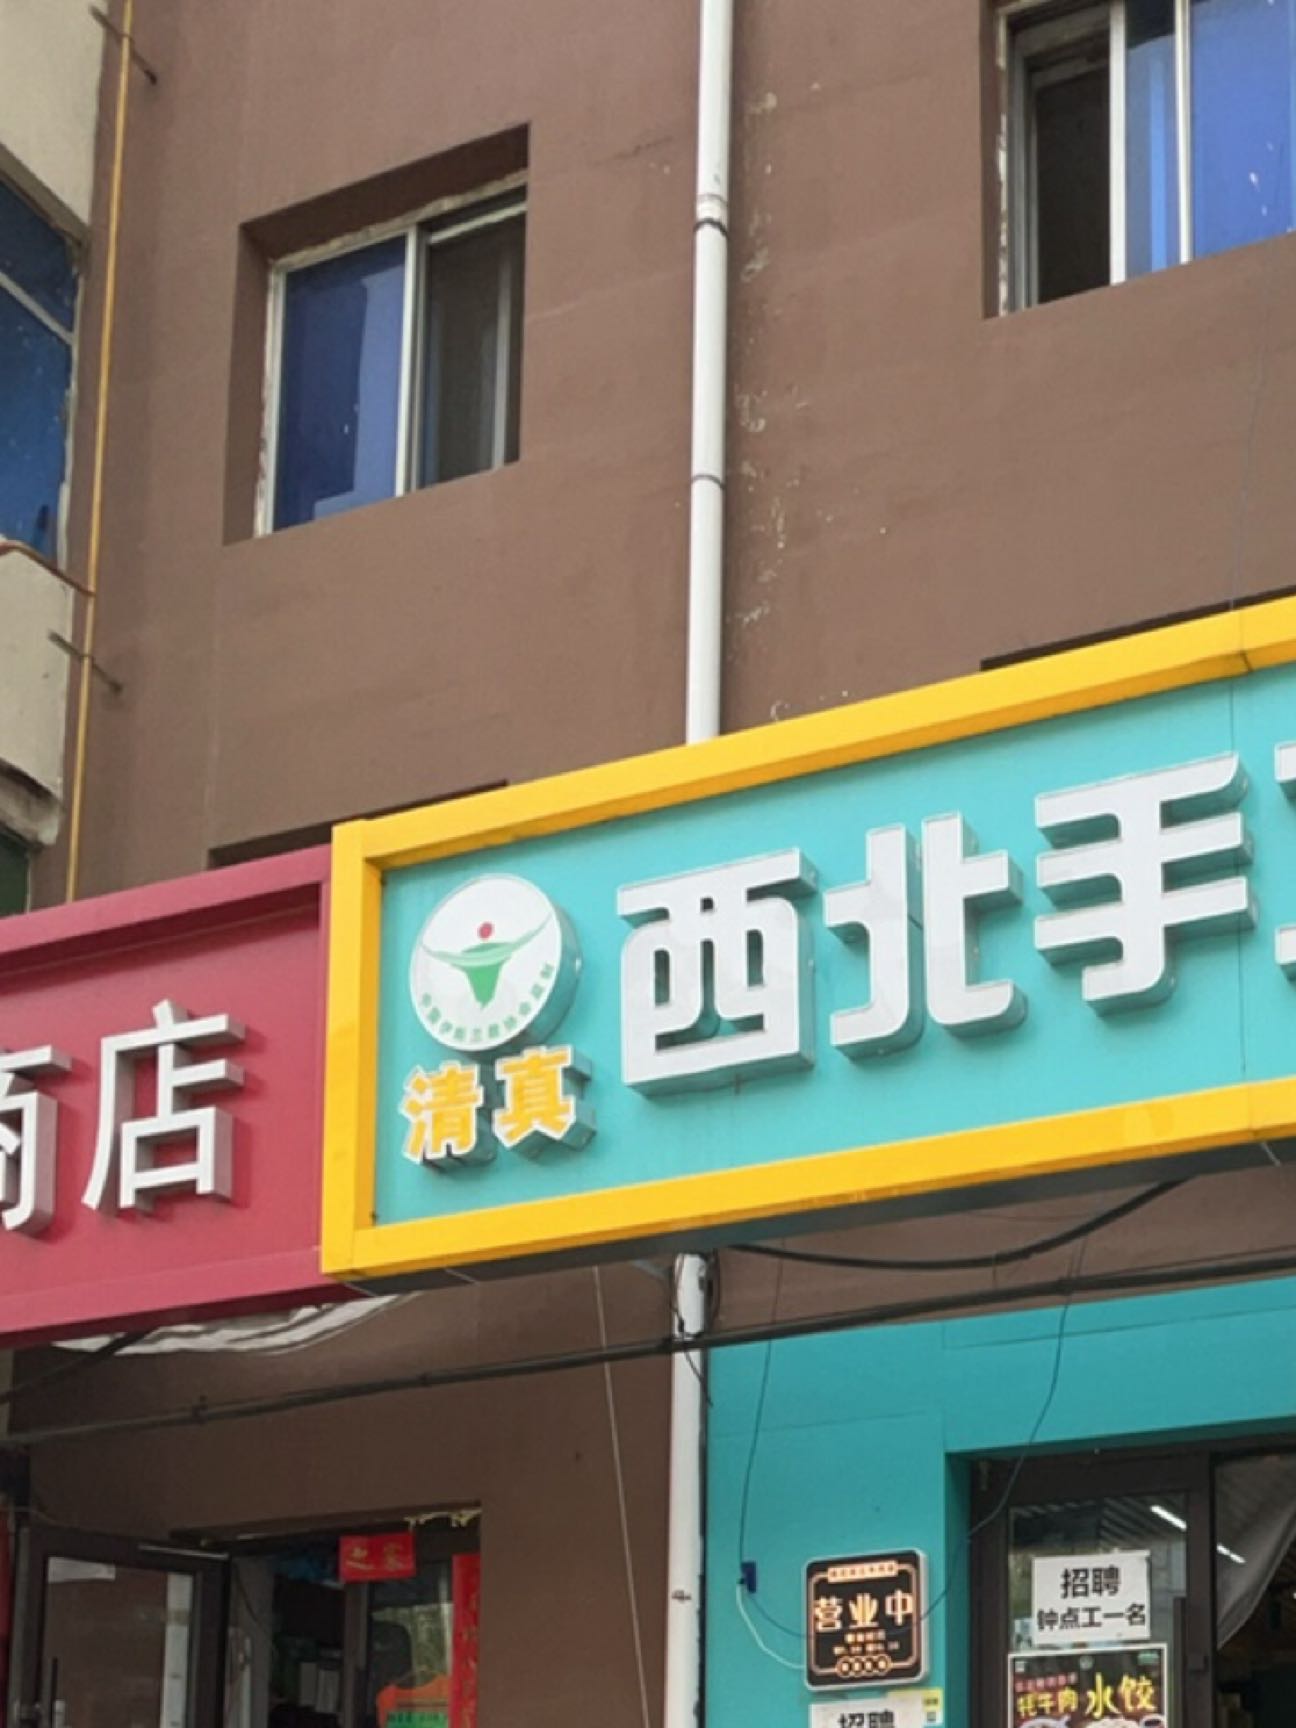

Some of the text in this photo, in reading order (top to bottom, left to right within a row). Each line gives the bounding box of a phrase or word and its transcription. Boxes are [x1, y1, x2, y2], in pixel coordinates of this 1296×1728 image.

[400, 1046, 577, 1163] 清真
[1060, 1564, 1121, 1599] 招聘
[813, 1588, 913, 1633] 营业中
[1037, 1602, 1146, 1632] 钟点工一名
[1084, 1671, 1158, 1719] 水饺
